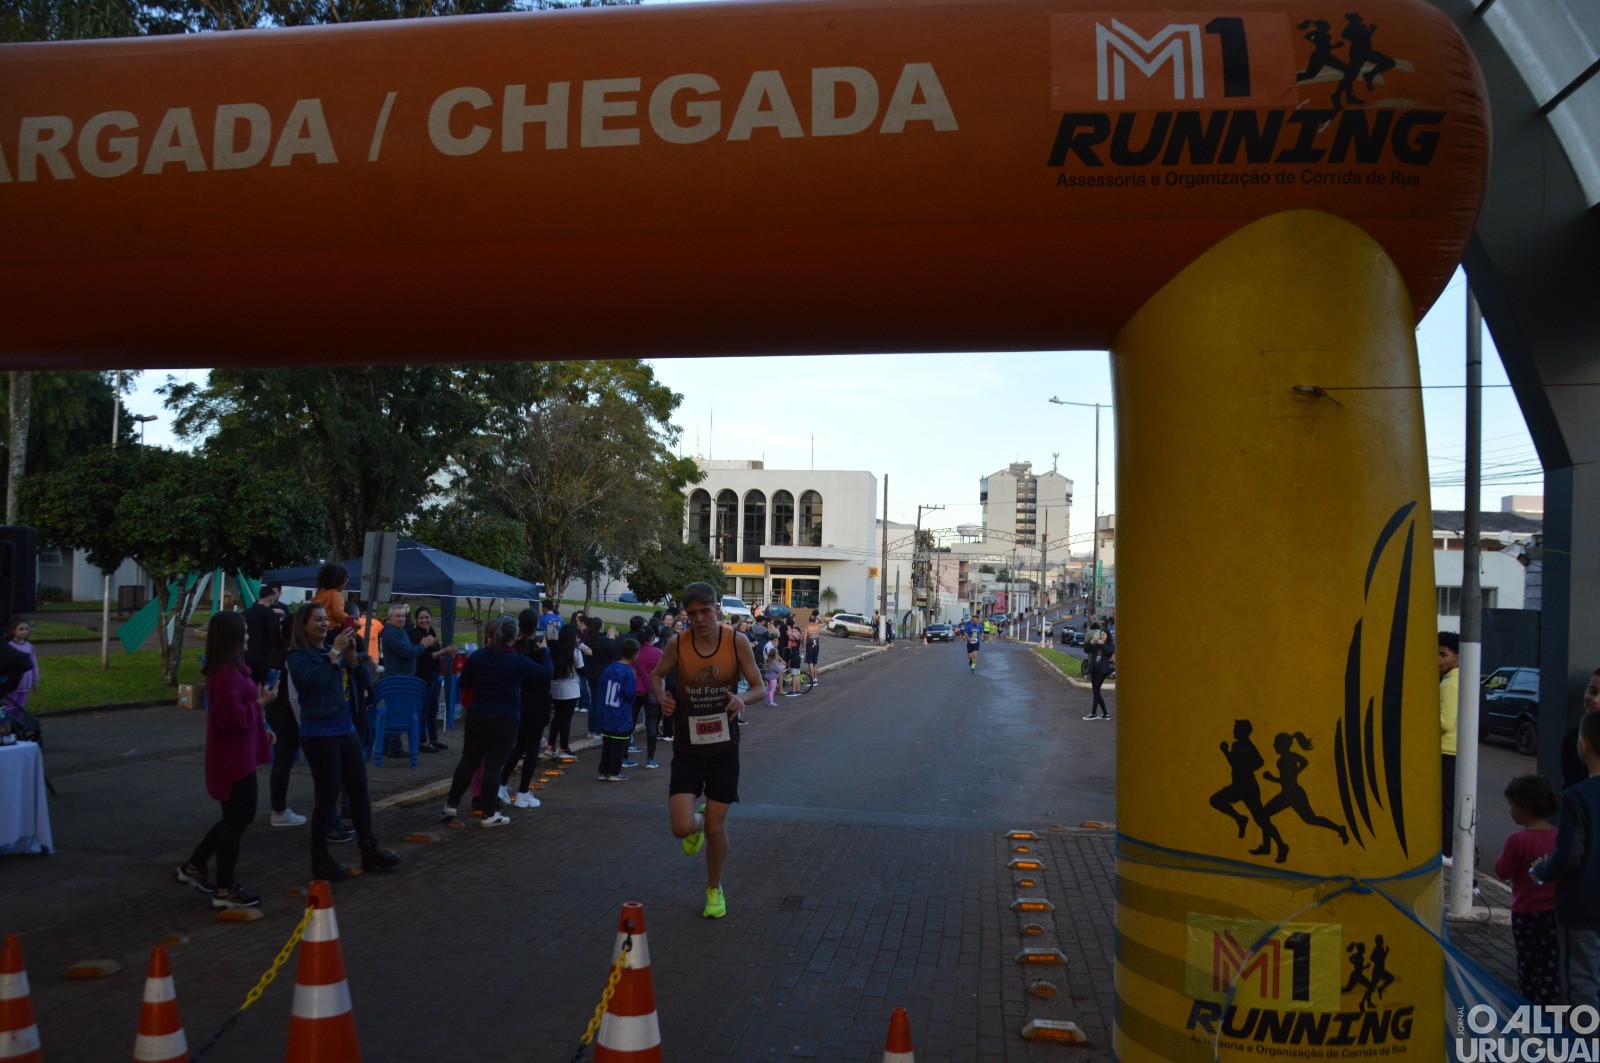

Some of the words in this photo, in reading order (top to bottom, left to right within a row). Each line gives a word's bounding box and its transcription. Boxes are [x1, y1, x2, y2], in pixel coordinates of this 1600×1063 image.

[1096, 16, 1252, 101] M1
[367, 91, 398, 162] /
[427, 61, 960, 157] CHEGADA
[1047, 109, 1447, 168] RUNNING
[1056, 171, 1146, 188] Assessoria
[1150, 174, 1161, 186] e
[1164, 169, 1271, 190] Organização
[1275, 170, 1297, 185] de
[1300, 168, 1362, 185] Corrida
[1365, 170, 1387, 185] de
[1390, 170, 1421, 187] Rua
[604, 679, 621, 708] 10
[700, 721, 720, 733] 068
[1213, 927, 1311, 1002] M1
[1186, 998, 1415, 1046] RUNNING
[1247, 1045, 1254, 1053] e
[1256, 1044, 1324, 1059] Organização
[1326, 1047, 1339, 1058] de
[1342, 1047, 1378, 1058] Corrida
[1380, 1045, 1390, 1056] de
[1392, 1044, 1407, 1054] Rua
